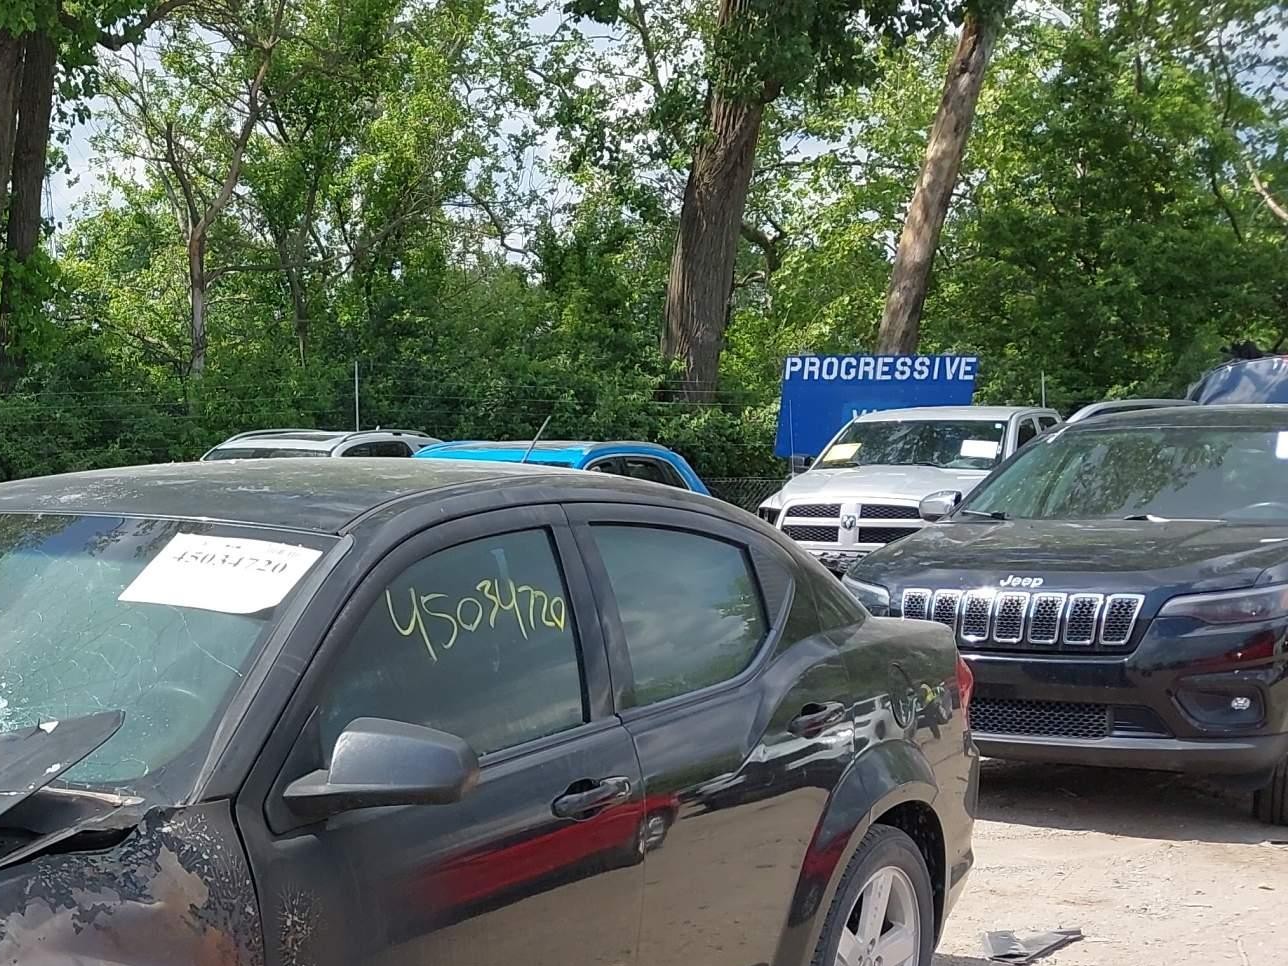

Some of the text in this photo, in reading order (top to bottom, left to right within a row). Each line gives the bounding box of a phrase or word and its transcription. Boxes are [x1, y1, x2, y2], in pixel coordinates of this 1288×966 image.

[785, 356, 977, 380] PROGRESSIVE
[173, 550, 289, 574] 45034720
[999, 574, 1044, 588] Jeep
[385, 579, 565, 663] 45034720
